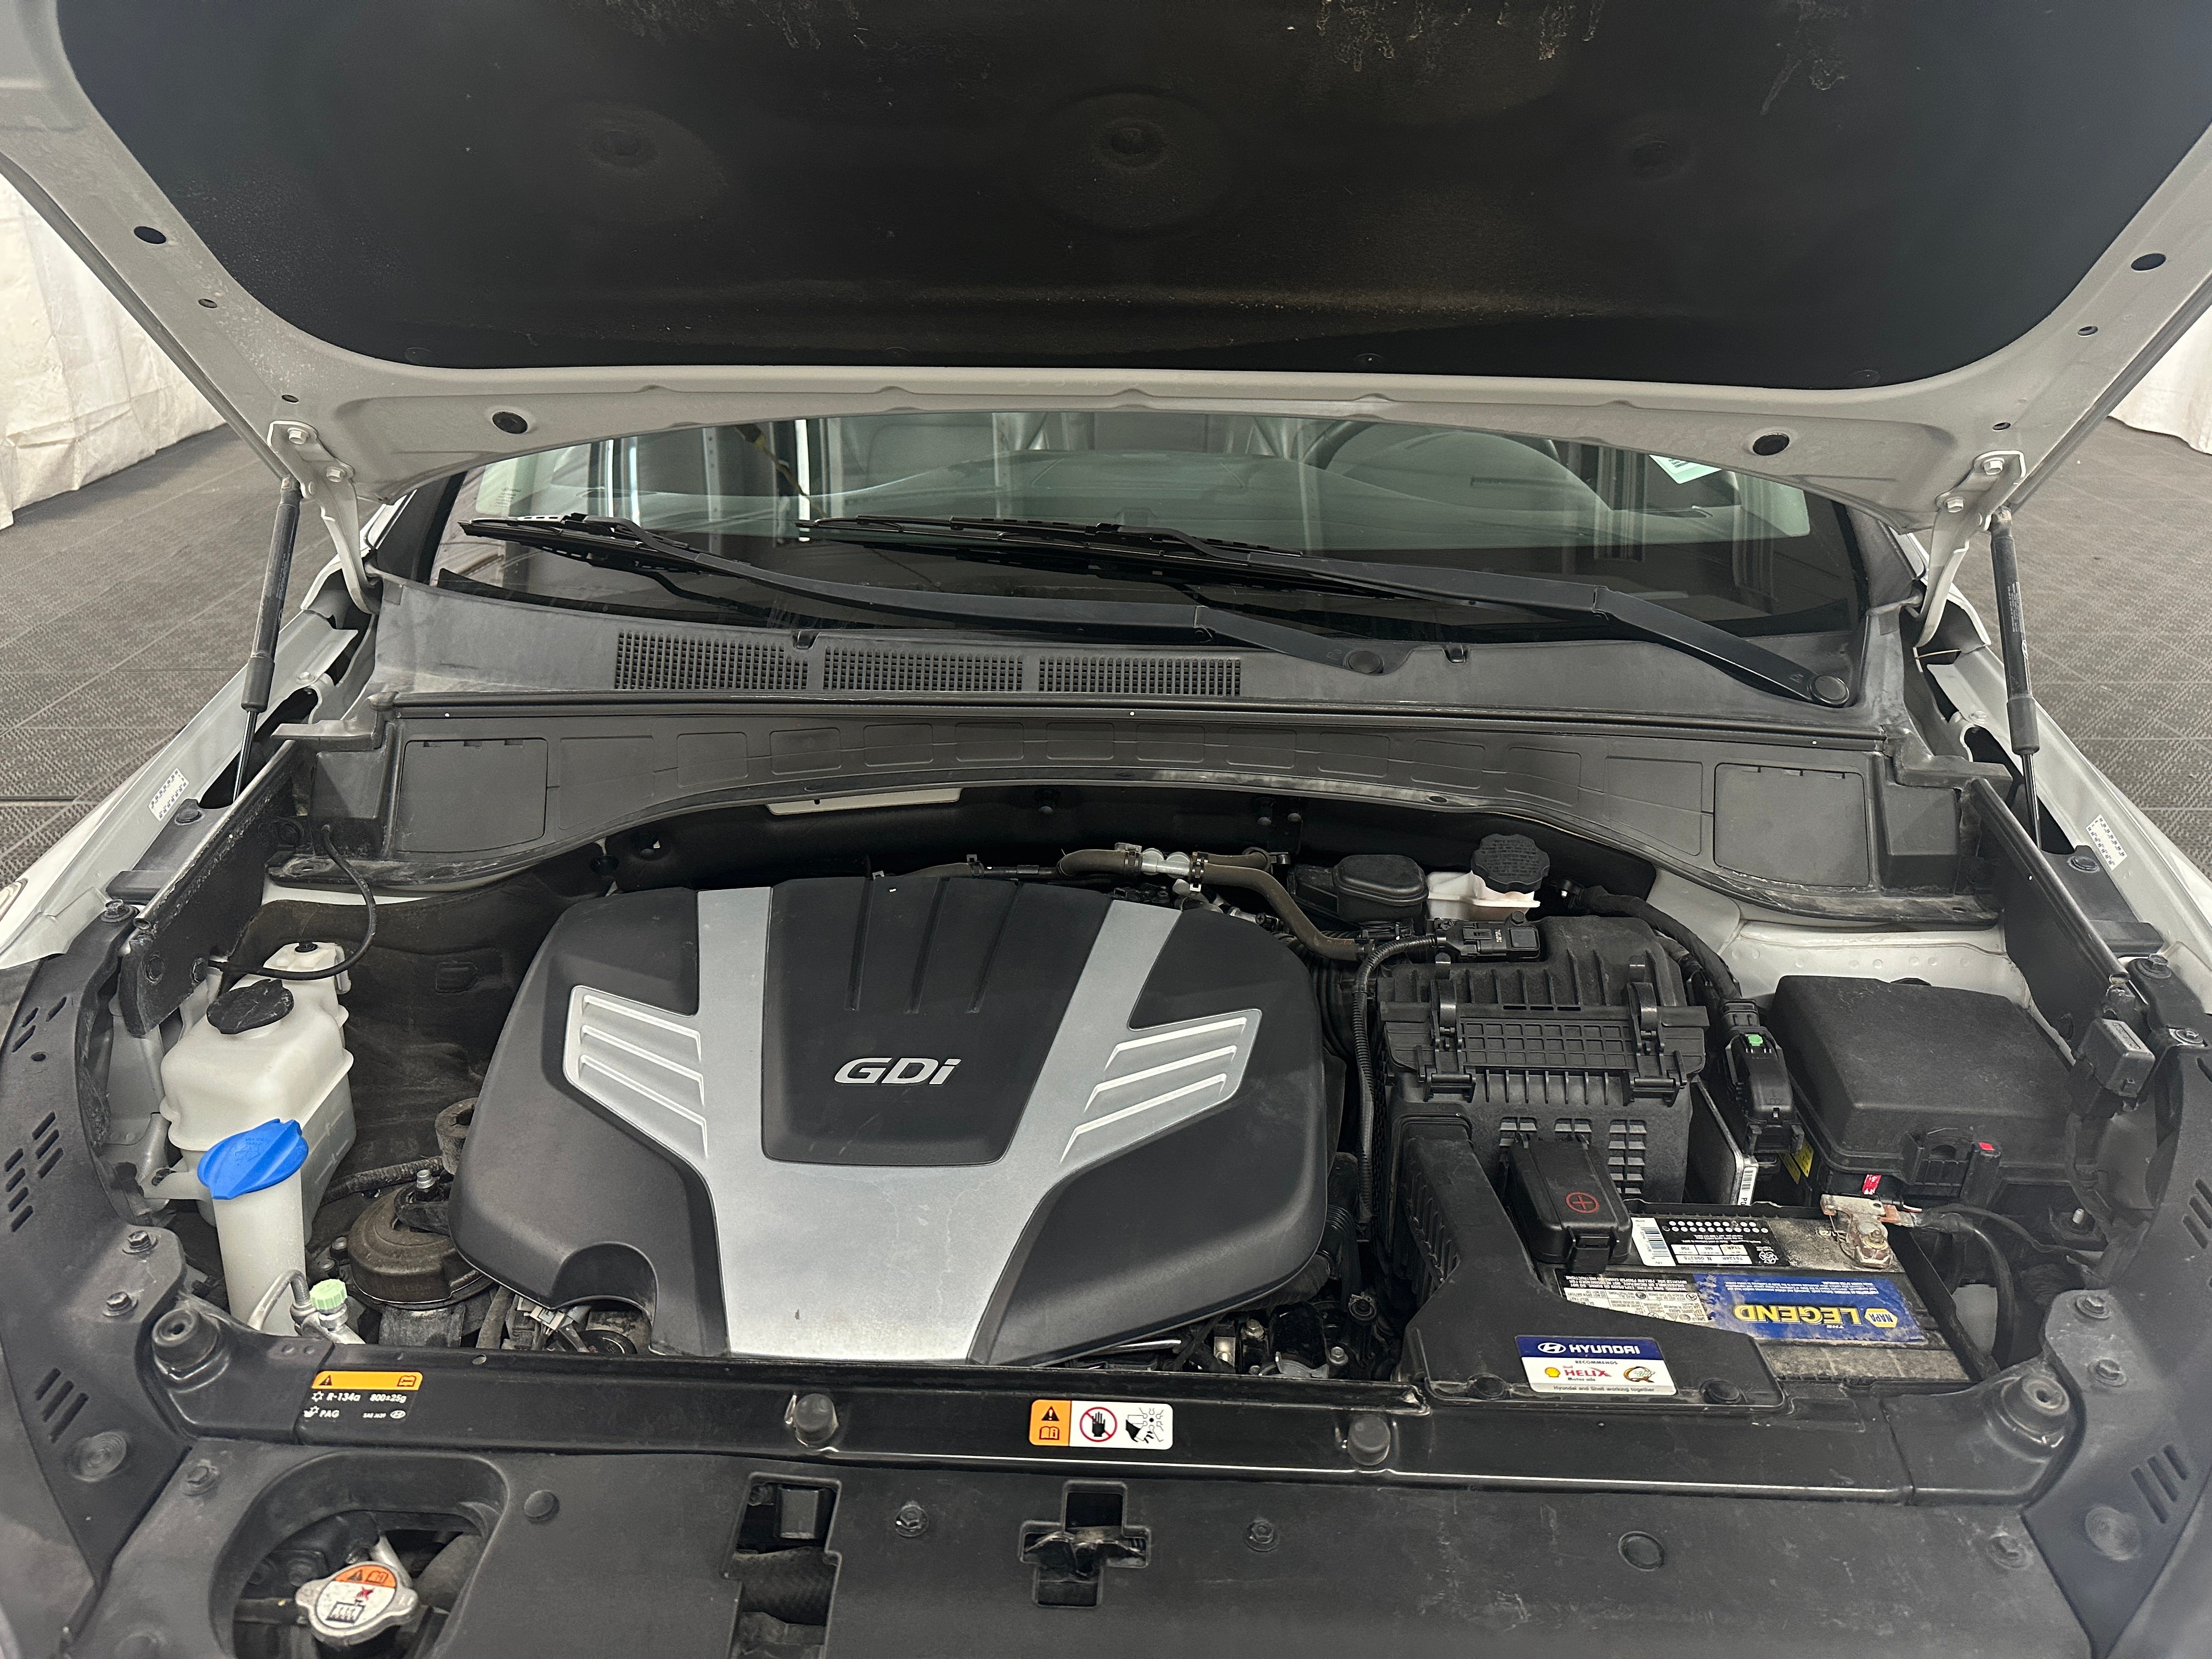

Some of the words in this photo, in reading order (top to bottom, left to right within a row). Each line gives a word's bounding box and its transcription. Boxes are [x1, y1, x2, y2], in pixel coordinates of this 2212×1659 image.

[834, 1057, 962, 1085] GDi
[1733, 1304, 1863, 1326] LEGEND
[1869, 1313, 1893, 1323] NAPA
[1568, 1344, 1640, 1355] HYUNDAI
[1565, 1368, 1612, 1378] HELIX
[326, 1392, 361, 1402] R-134a
[319, 1410, 340, 1418] PAG
